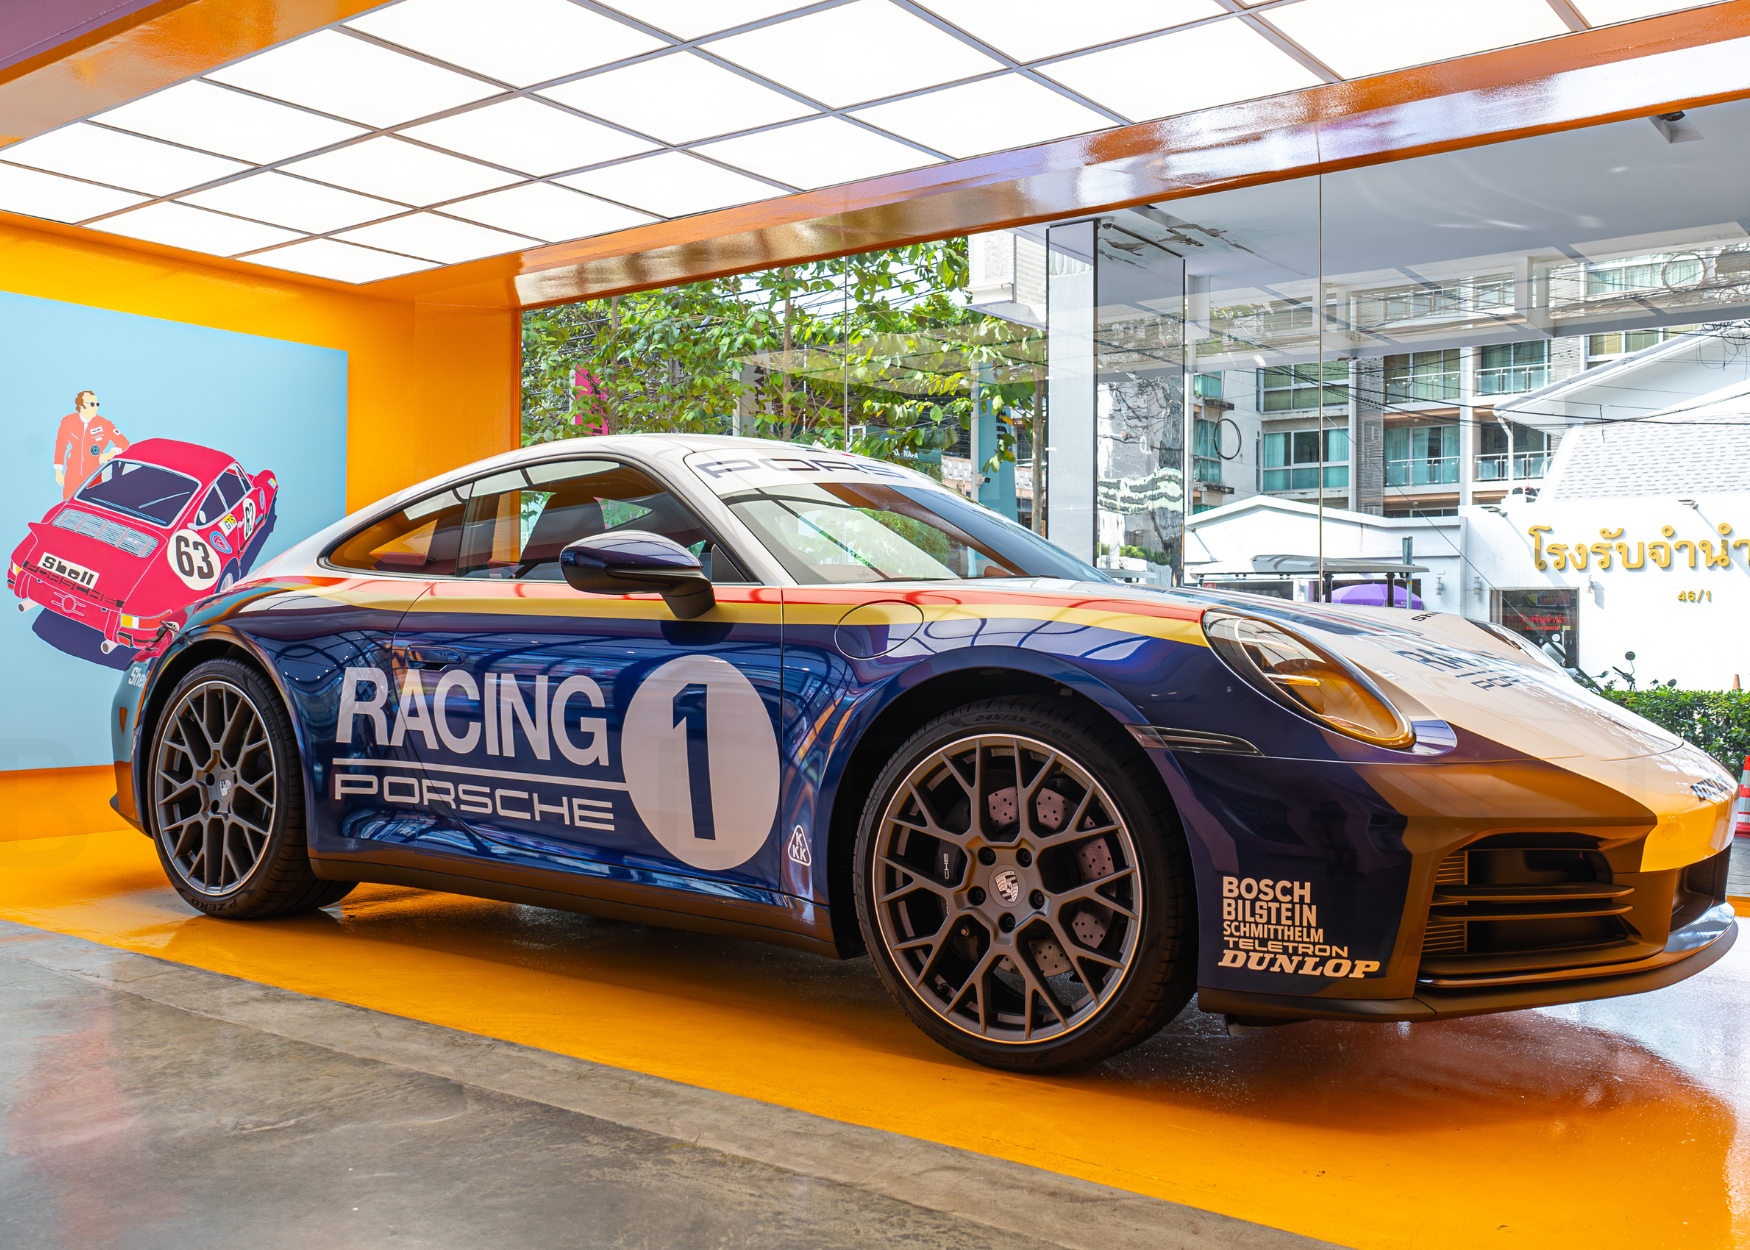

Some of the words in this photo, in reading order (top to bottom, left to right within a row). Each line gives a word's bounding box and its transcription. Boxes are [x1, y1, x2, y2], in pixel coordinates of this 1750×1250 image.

[175, 535, 214, 579] 63
[1528, 522, 1750, 571] โรงรับจำนำ
[42, 555, 95, 586] Shell
[1677, 589, 1712, 603] 46/1
[335, 666, 610, 767] RACING
[672, 682, 716, 841] 1
[334, 772, 616, 832] PORSCHE
[1222, 875, 1311, 904] BOSCH
[1222, 898, 1317, 928] BILSTEIN
[1223, 920, 1324, 944] SCHMITTHELM
[1223, 936, 1349, 958] TELETRON
[1217, 949, 1381, 979] DUNLOP
